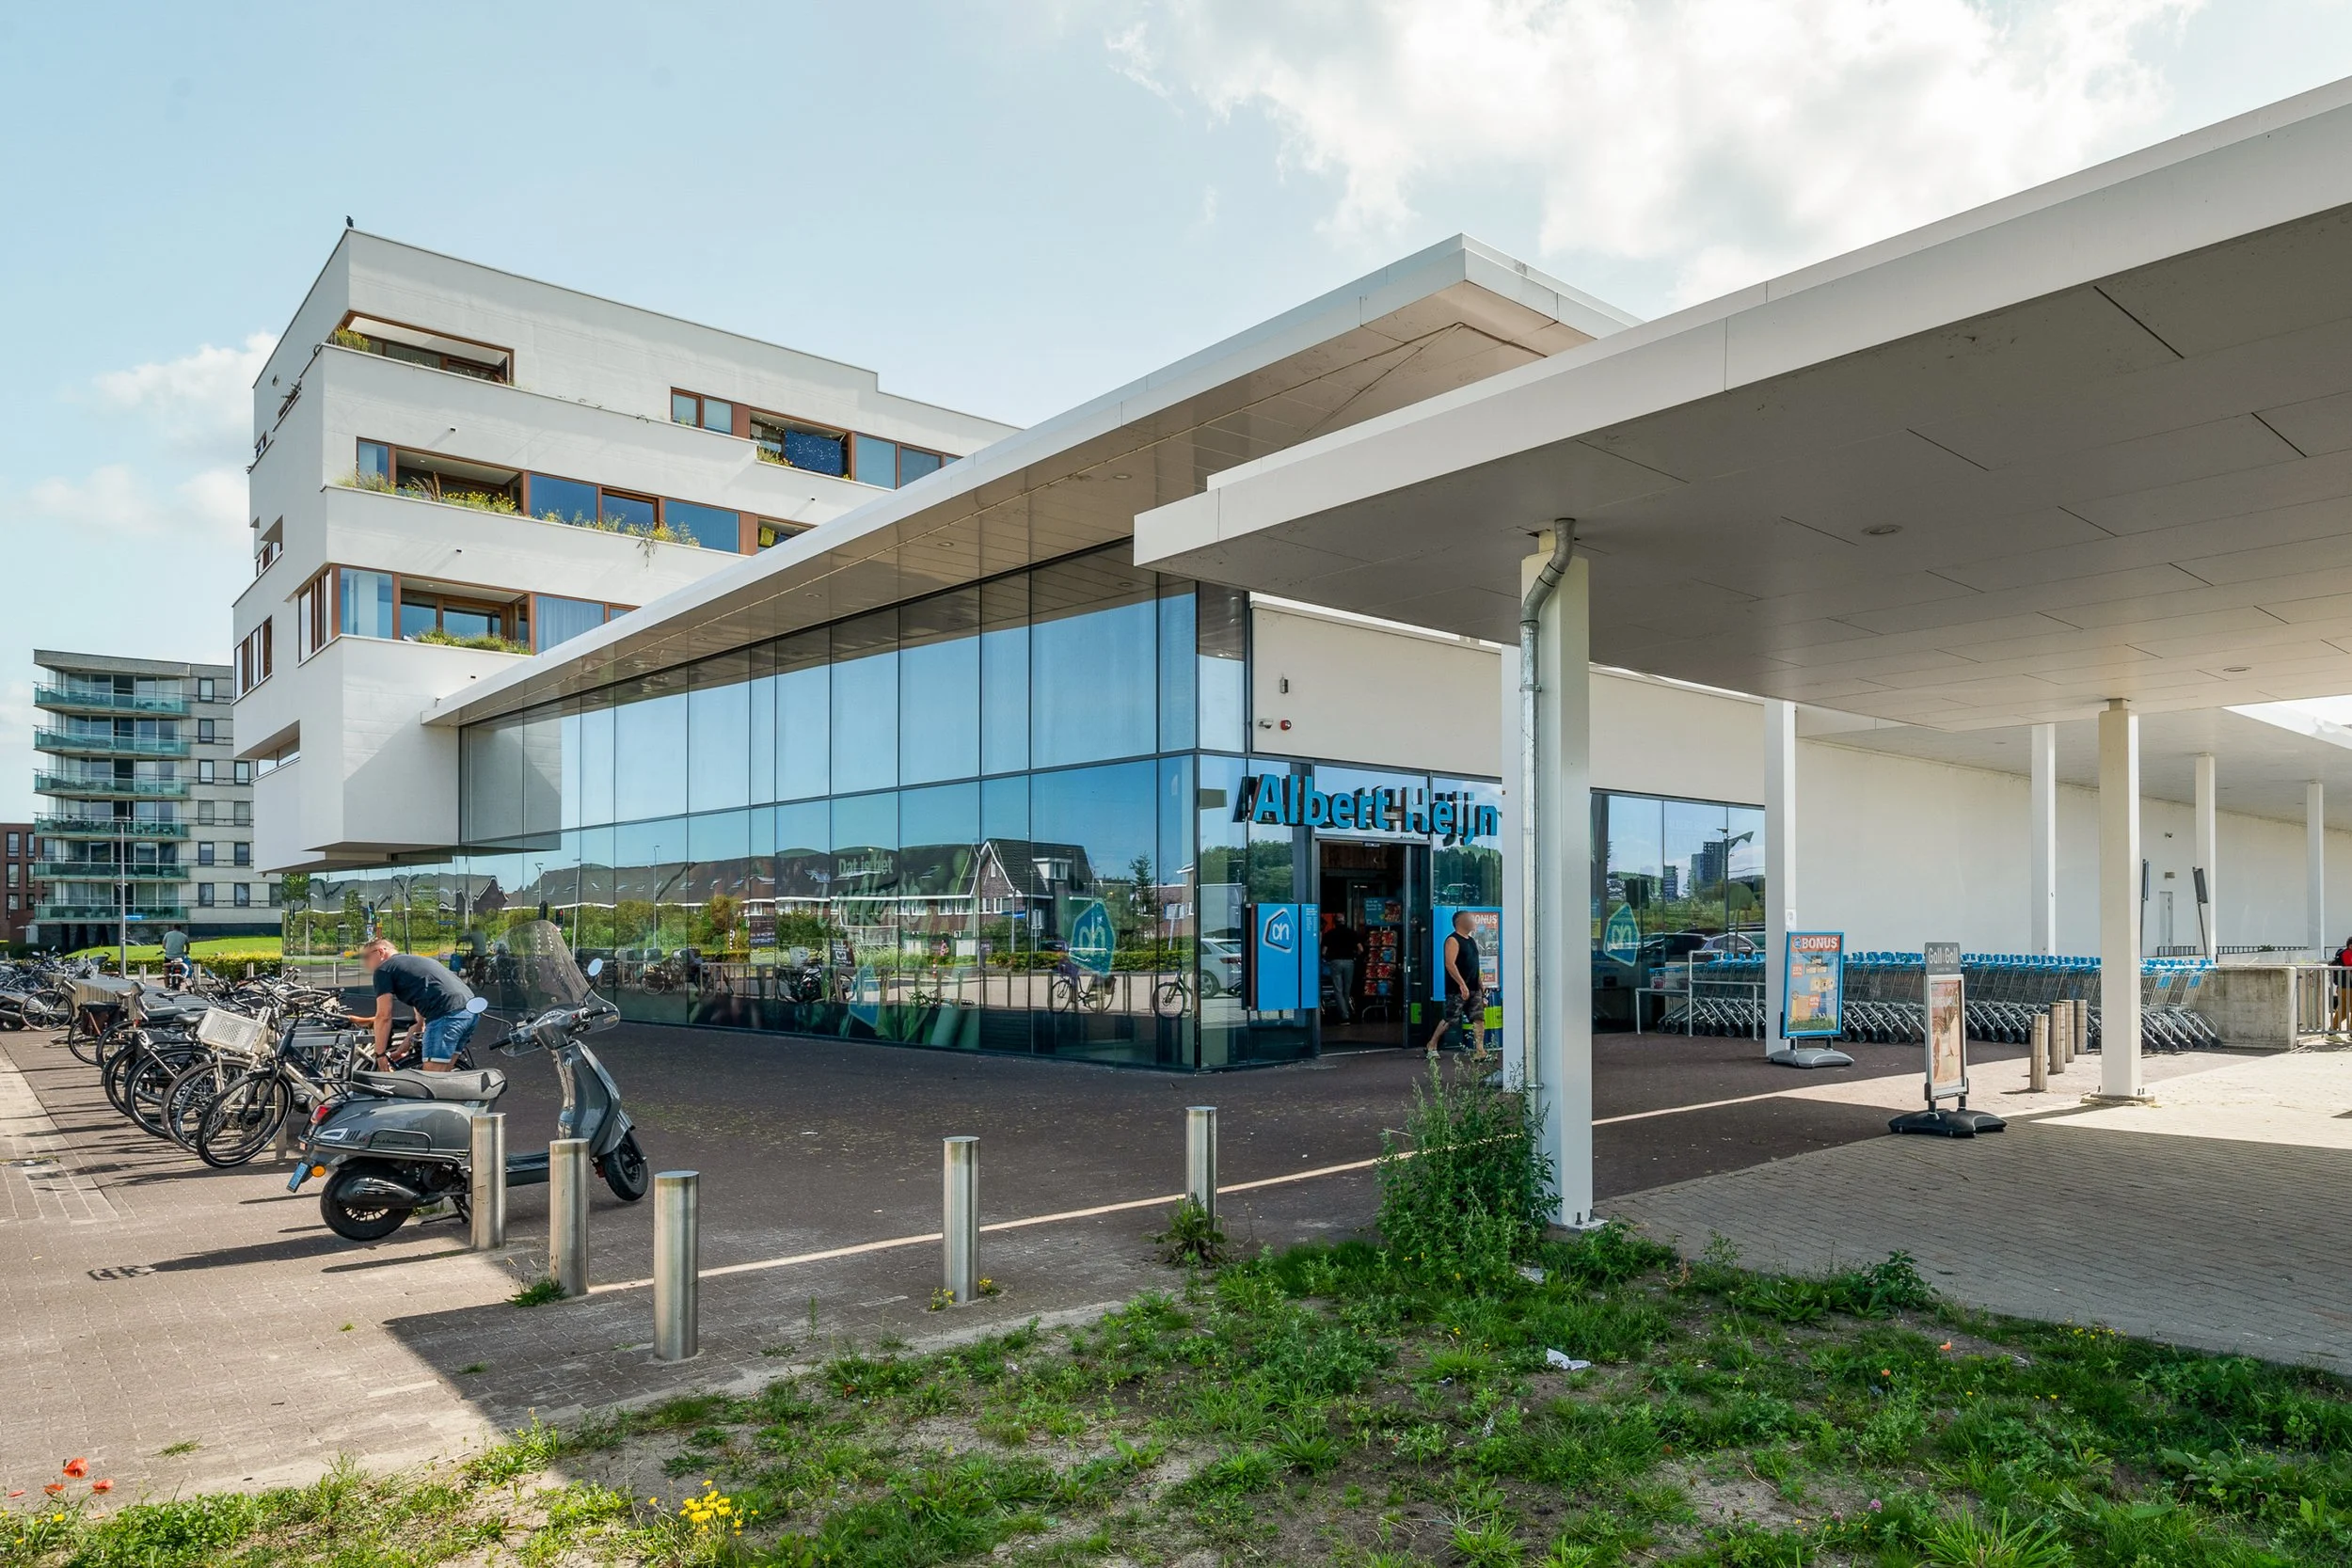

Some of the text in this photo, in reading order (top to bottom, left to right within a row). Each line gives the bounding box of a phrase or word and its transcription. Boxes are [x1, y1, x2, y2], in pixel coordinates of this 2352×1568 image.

[1251, 773, 1498, 846] Albert Heijn
[838, 857, 858, 876] Dat
[1470, 914, 1498, 925] ONUS
[1801, 937, 1837, 950] BONUS
[1929, 947, 1943, 964] Gall
[1946, 947, 1959, 964] Gall
